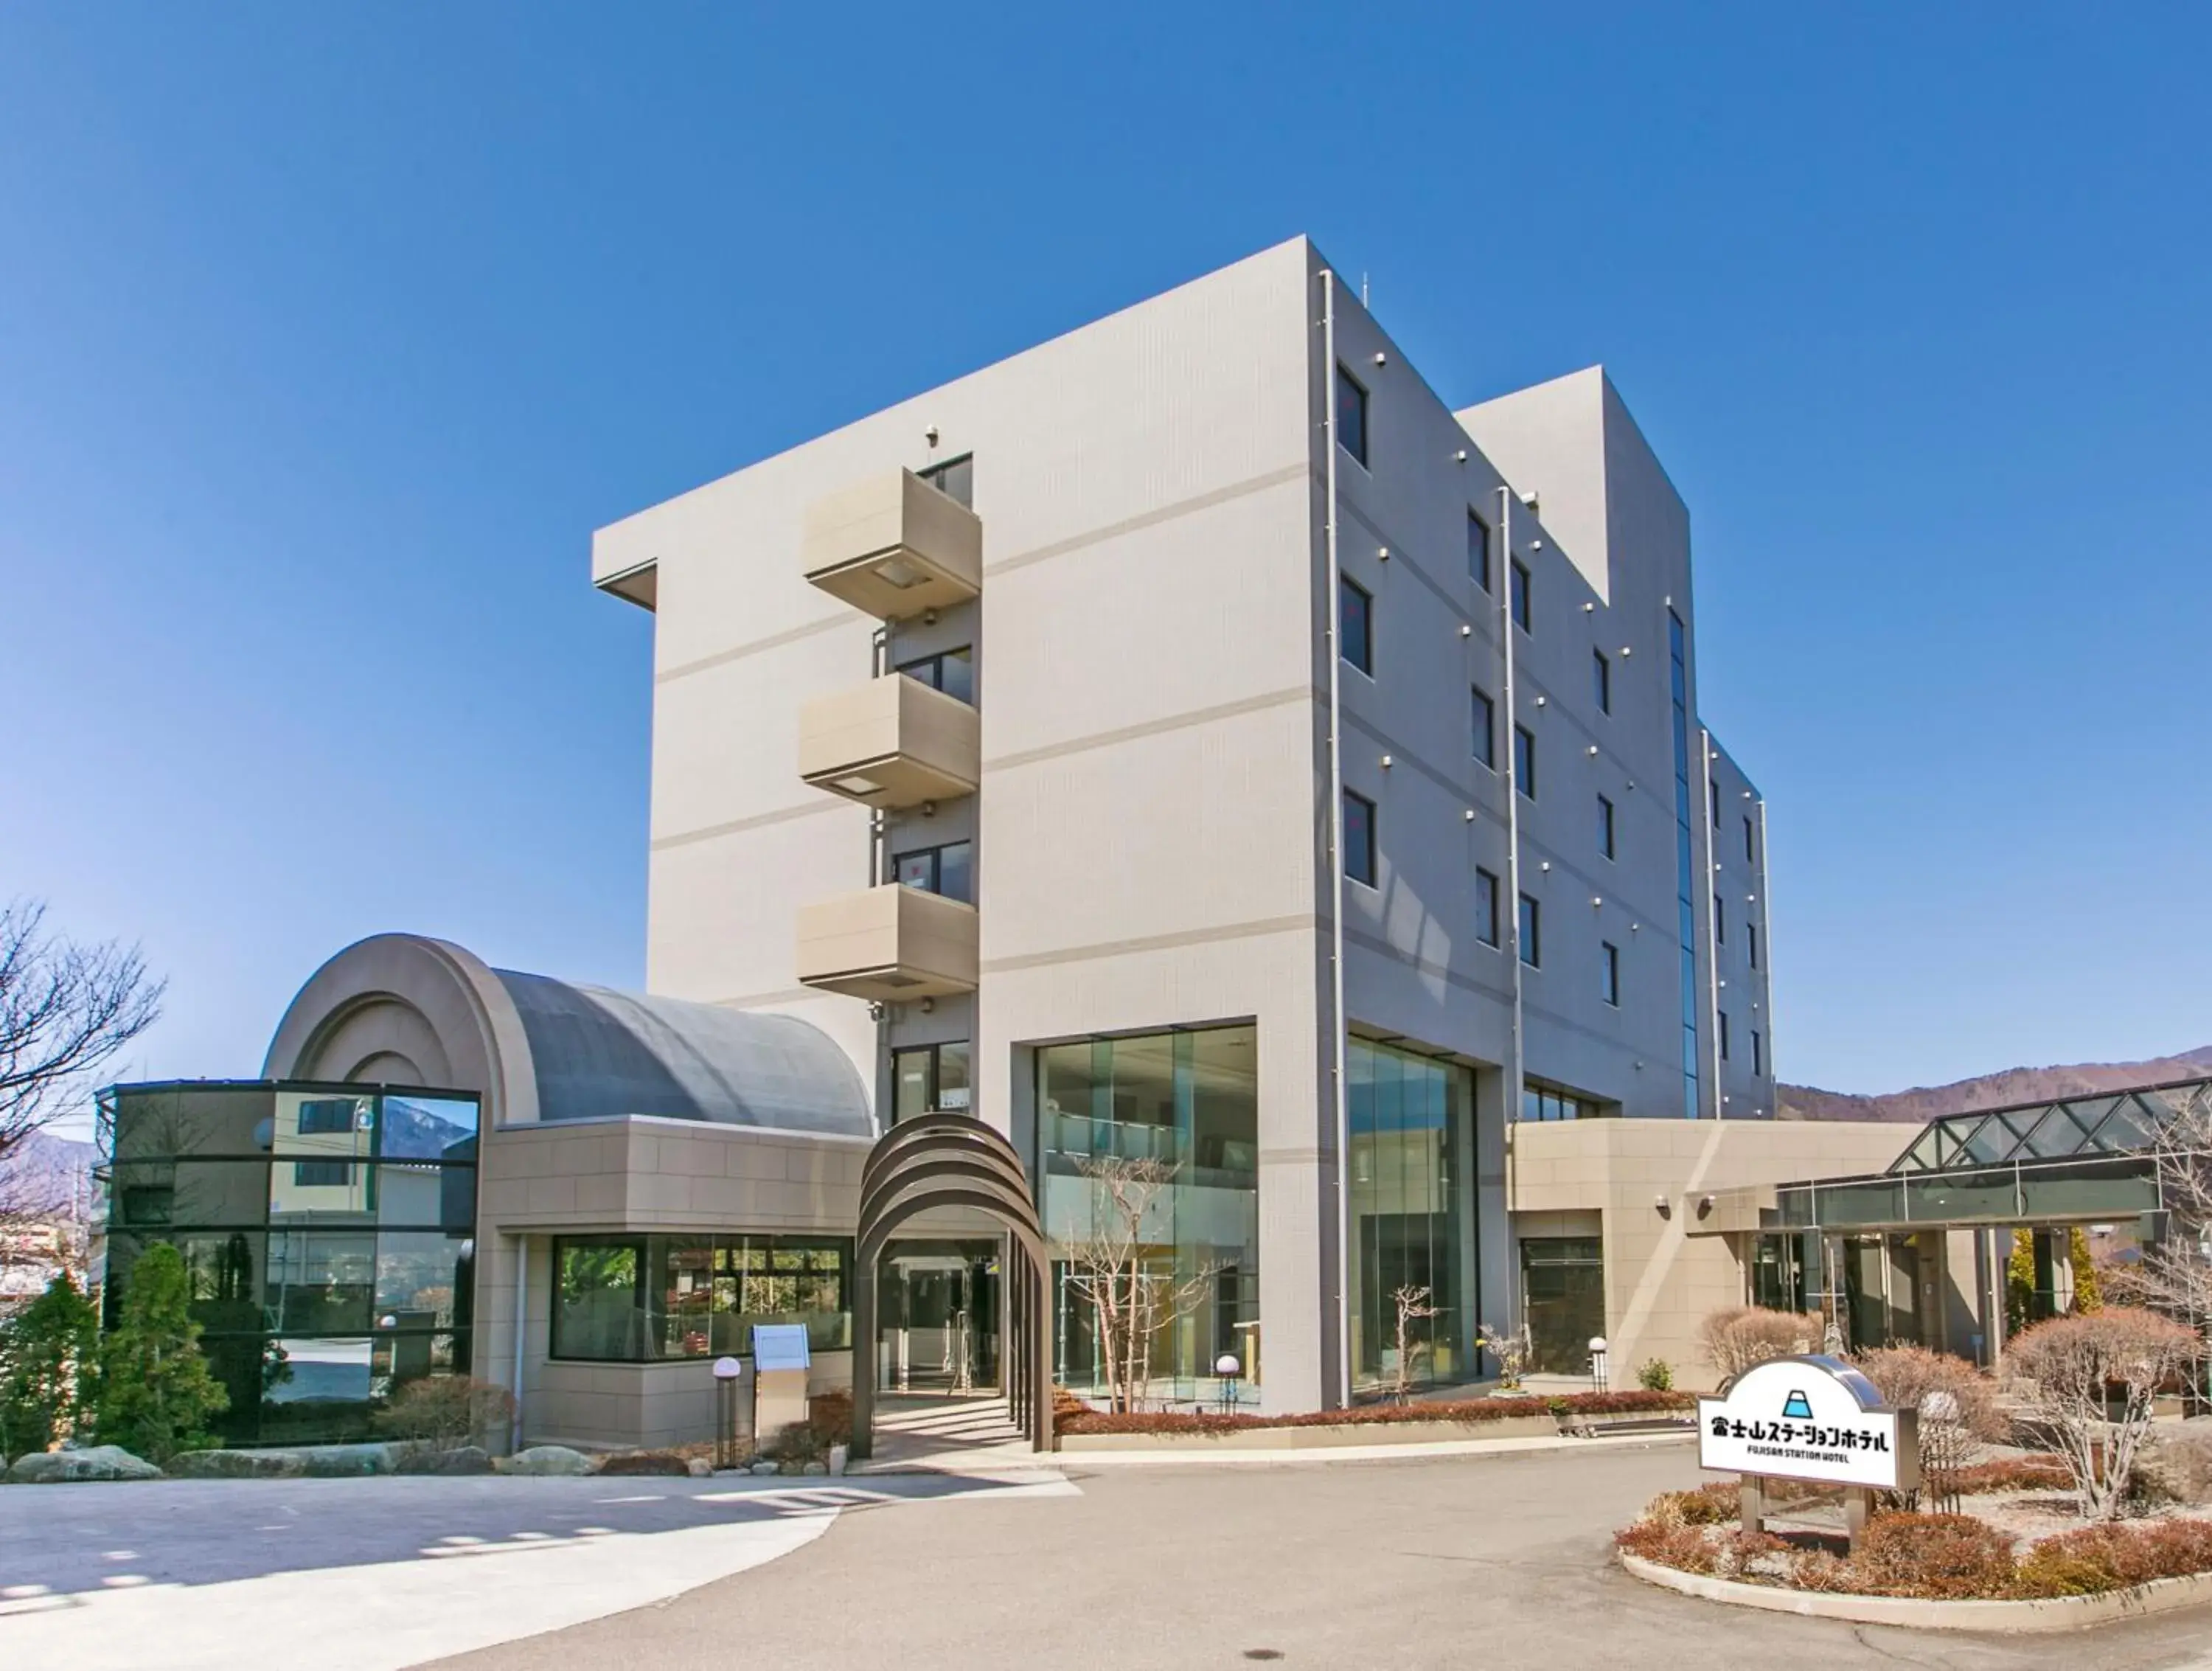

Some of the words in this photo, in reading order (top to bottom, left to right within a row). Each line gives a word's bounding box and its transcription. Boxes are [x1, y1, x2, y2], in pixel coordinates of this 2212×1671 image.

[1711, 1416, 1890, 1452] 富士山ステーションホテル
[1747, 1445, 1784, 1456] FUJISAN
[1784, 1448, 1820, 1460] STATION
[1822, 1452, 1849, 1464] HOTEL
